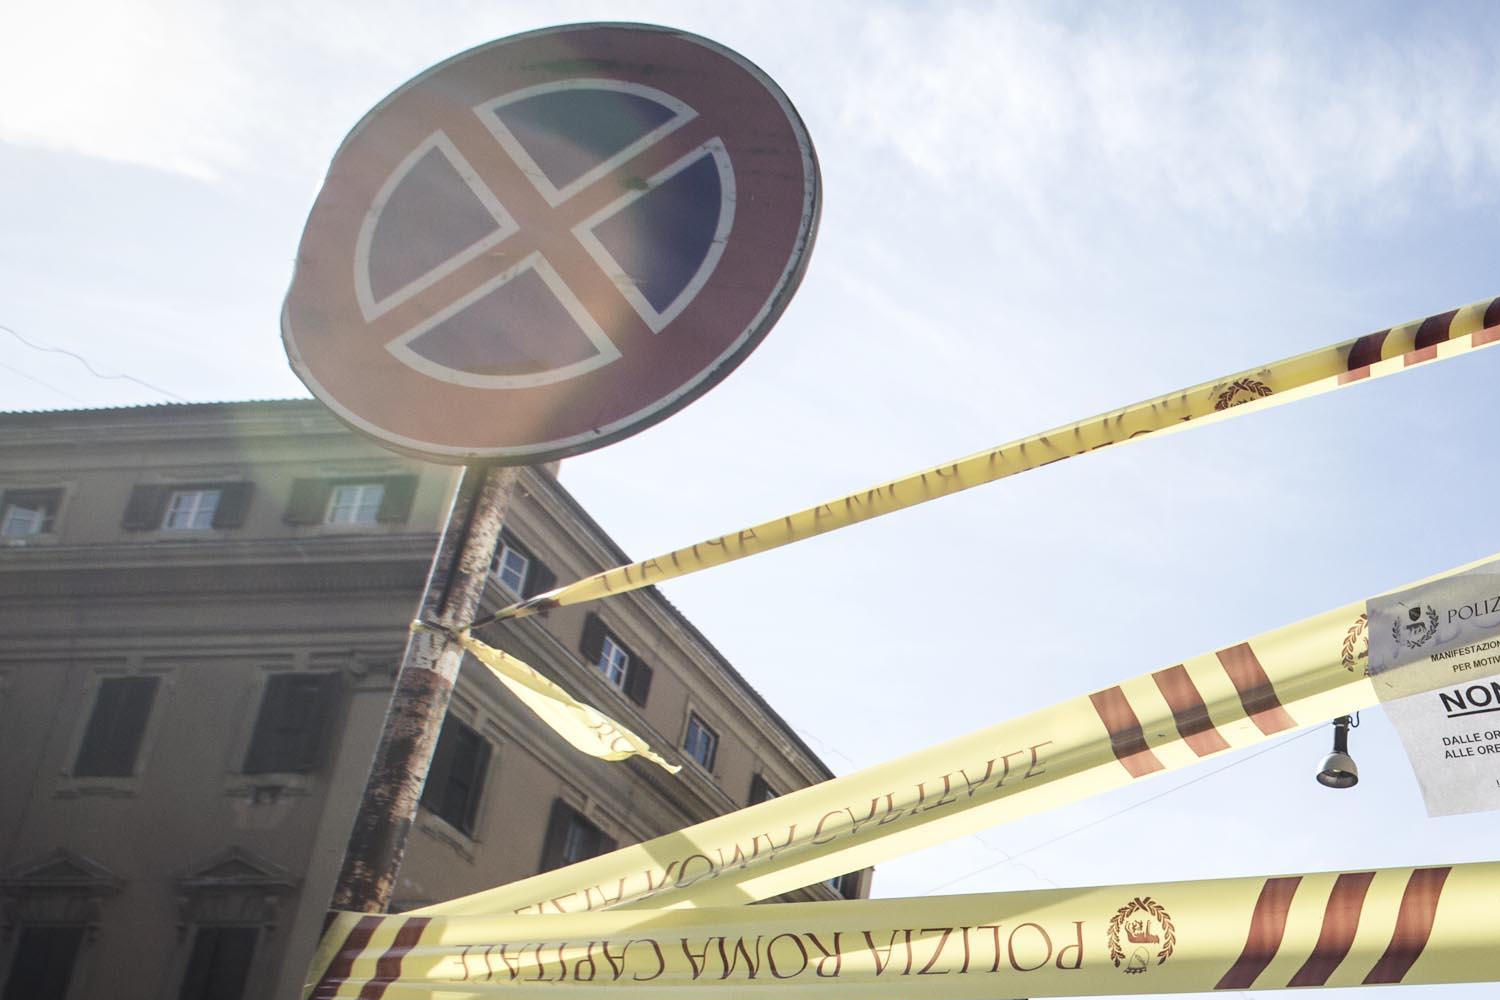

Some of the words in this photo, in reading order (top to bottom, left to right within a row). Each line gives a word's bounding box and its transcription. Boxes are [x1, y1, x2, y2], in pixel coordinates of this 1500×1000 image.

[1452, 662, 1472, 673] PER
[1442, 731, 1482, 747] DALLE
[1445, 745, 1475, 759] ALLE
[451, 938, 666, 982] CAPITALE
[680, 931, 843, 980] ROMA
[861, 921, 1086, 976] POLIZIA
